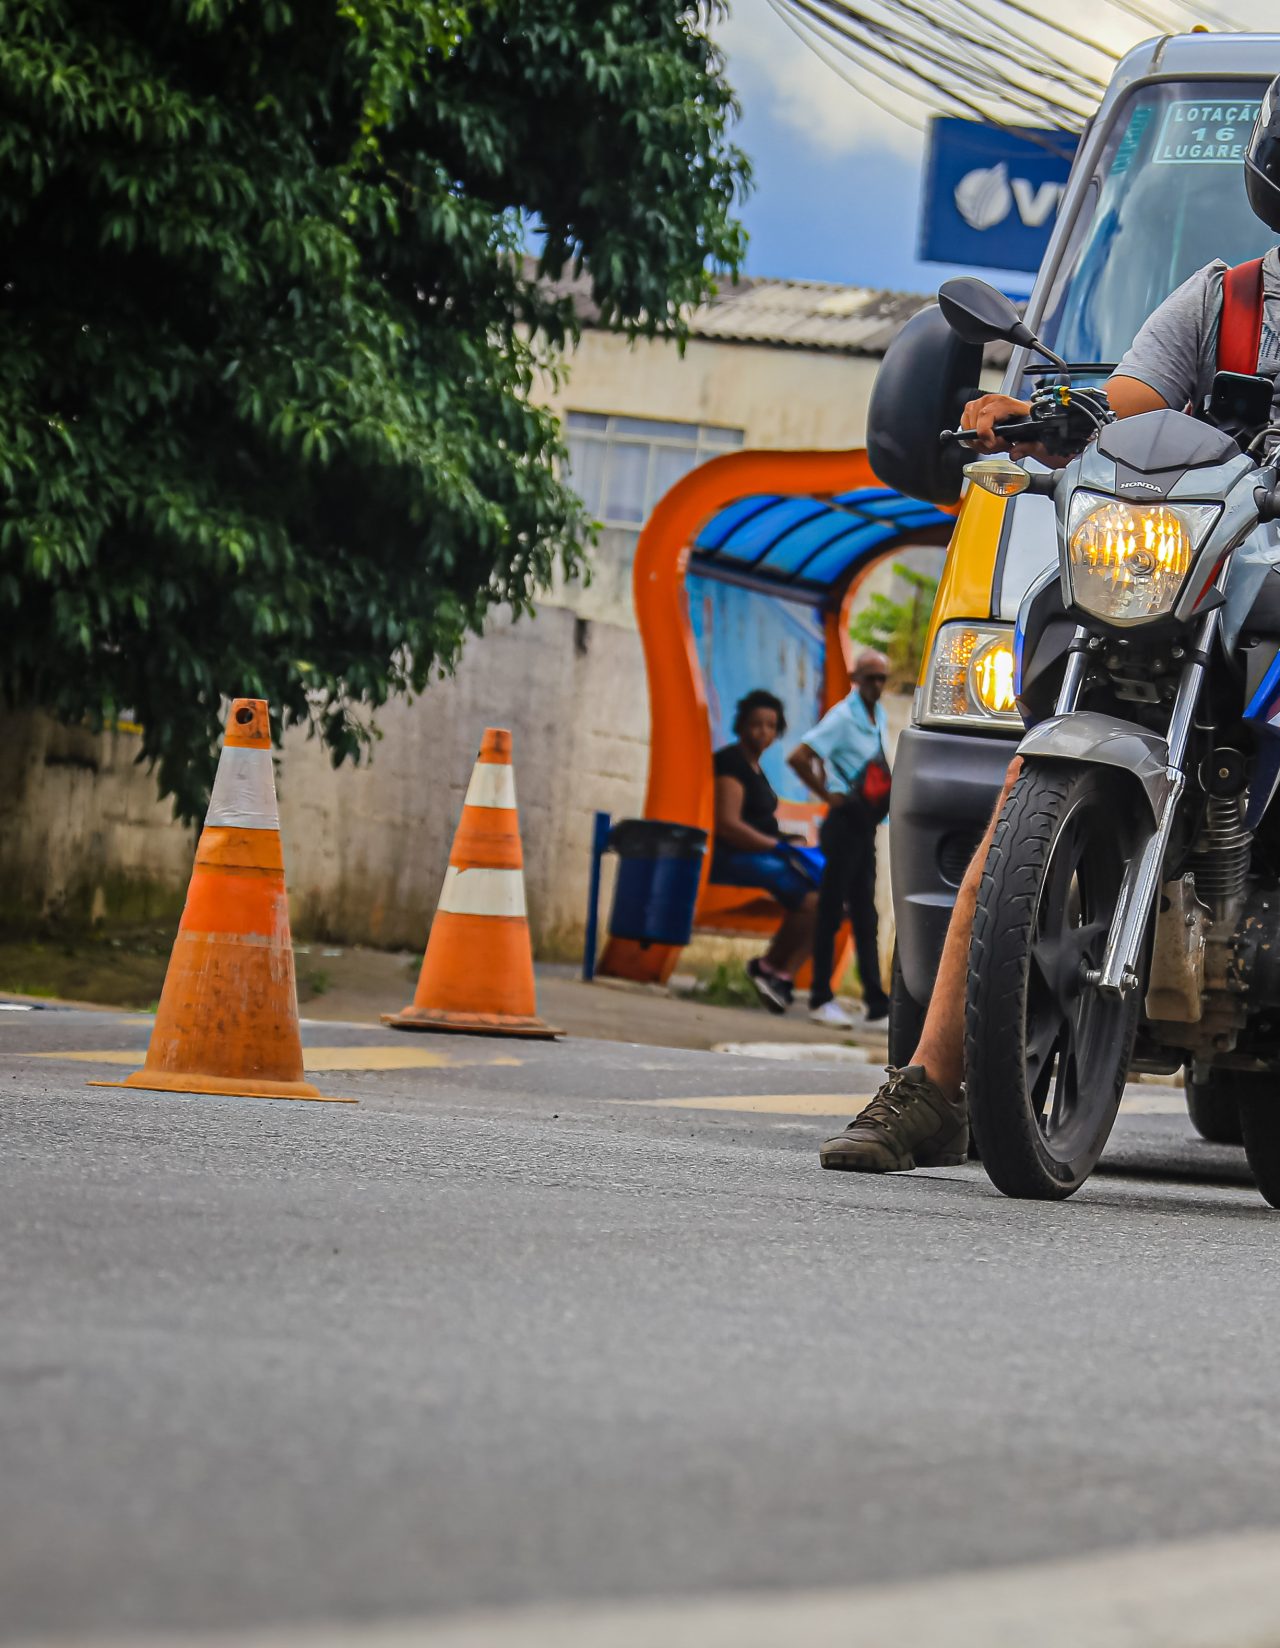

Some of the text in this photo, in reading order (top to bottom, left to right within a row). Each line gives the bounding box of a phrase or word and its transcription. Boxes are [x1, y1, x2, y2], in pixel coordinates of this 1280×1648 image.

[1192, 127, 1236, 142] 16
[1163, 144, 1248, 159] LUGARE
[1120, 481, 1163, 493] HONDA
